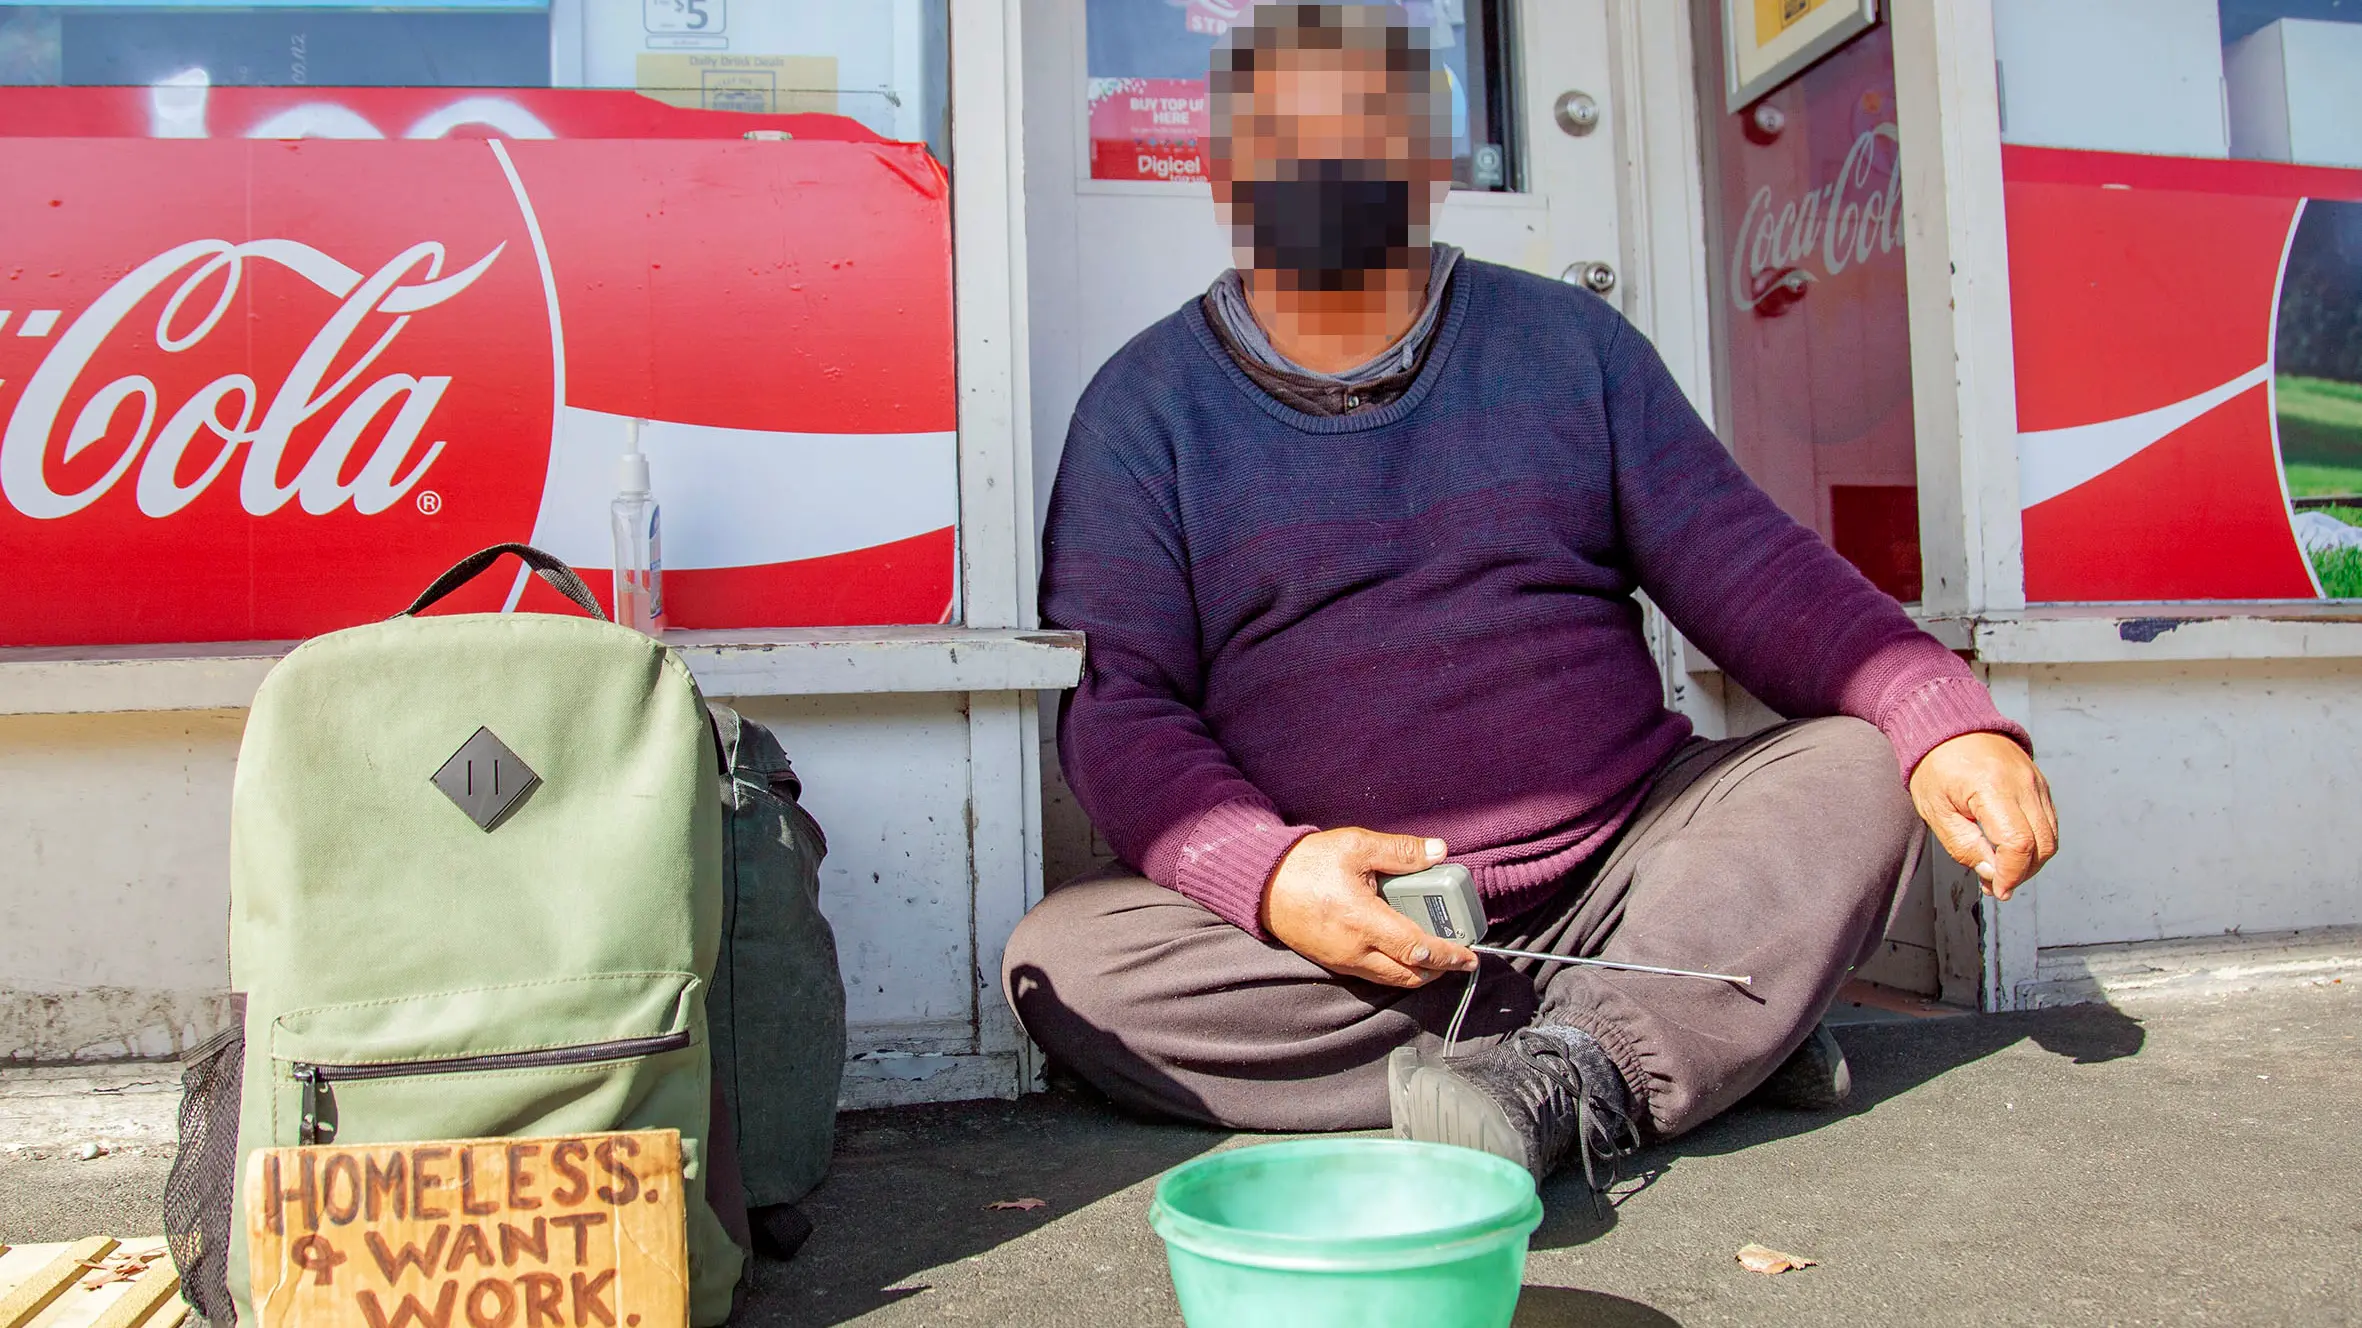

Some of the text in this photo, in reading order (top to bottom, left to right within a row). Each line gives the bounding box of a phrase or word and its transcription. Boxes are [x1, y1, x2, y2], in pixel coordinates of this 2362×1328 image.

[689, 55, 717, 68] Daily
[1130, 97, 1157, 112] BUY
[1159, 97, 1187, 112] TOP
[1152, 111, 1190, 125] HERE
[1137, 155, 1201, 178] Digicel
[1731, 122, 1904, 311] Coca-Col
[263, 1136, 659, 1236] HOMELESS.
[364, 1212, 607, 1287] WANT
[355, 1268, 642, 1328] WORK.
